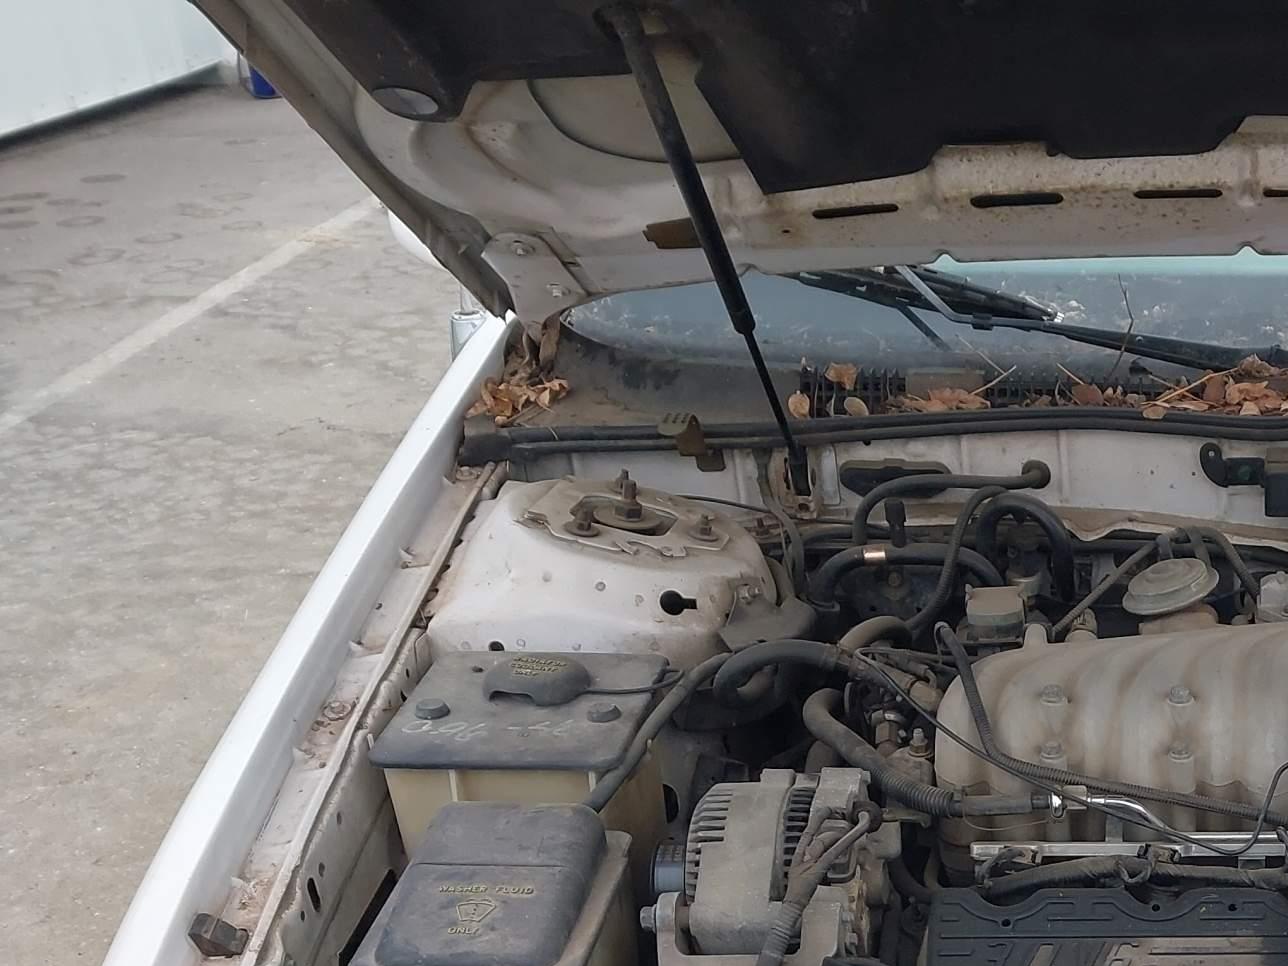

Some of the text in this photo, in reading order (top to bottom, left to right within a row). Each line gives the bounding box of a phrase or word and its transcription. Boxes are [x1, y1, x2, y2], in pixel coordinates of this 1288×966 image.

[439, 885, 535, 895] WASHER FLUID
[447, 927, 480, 936] ONLY
